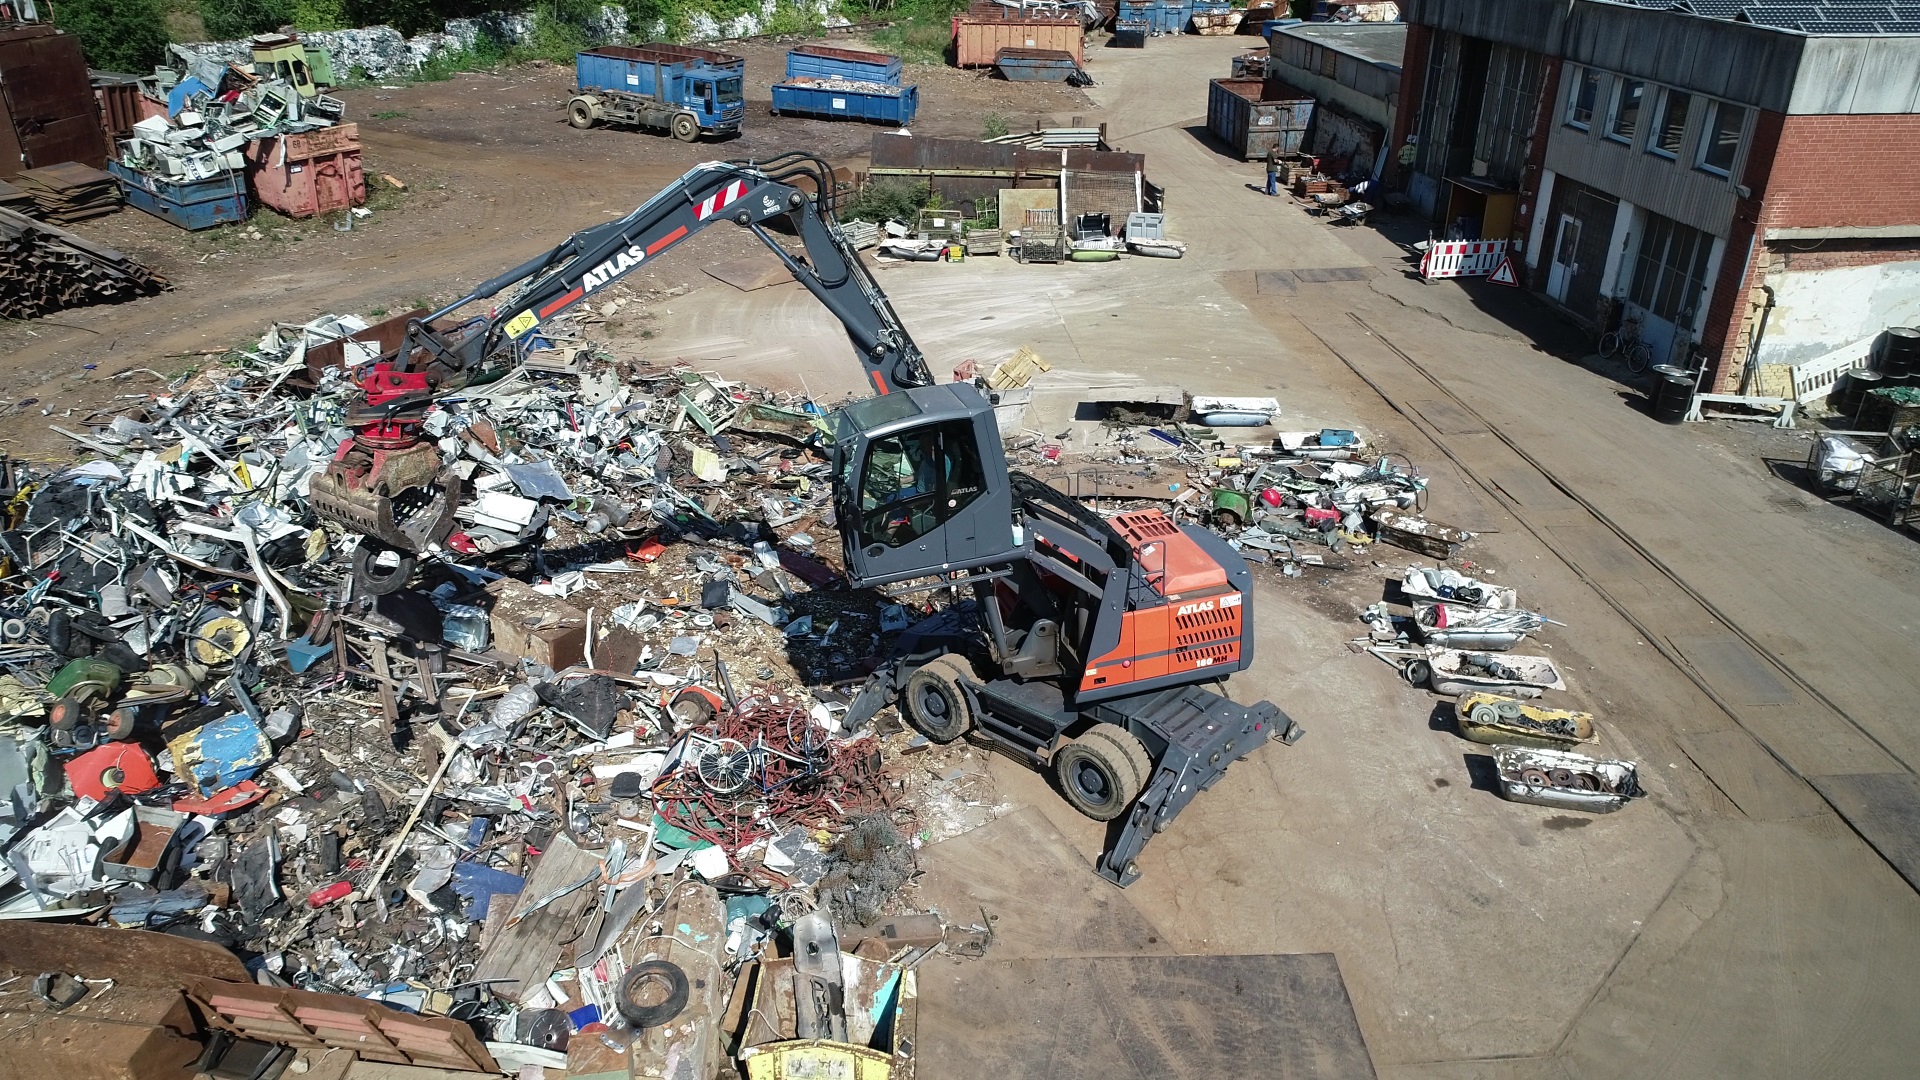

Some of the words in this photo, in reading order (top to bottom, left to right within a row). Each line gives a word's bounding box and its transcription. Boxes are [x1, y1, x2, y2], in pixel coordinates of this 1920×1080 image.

[582, 245, 645, 293] ATLAS
[957, 486, 978, 495] ATLAS
[1177, 601, 1215, 616] ATLAS
